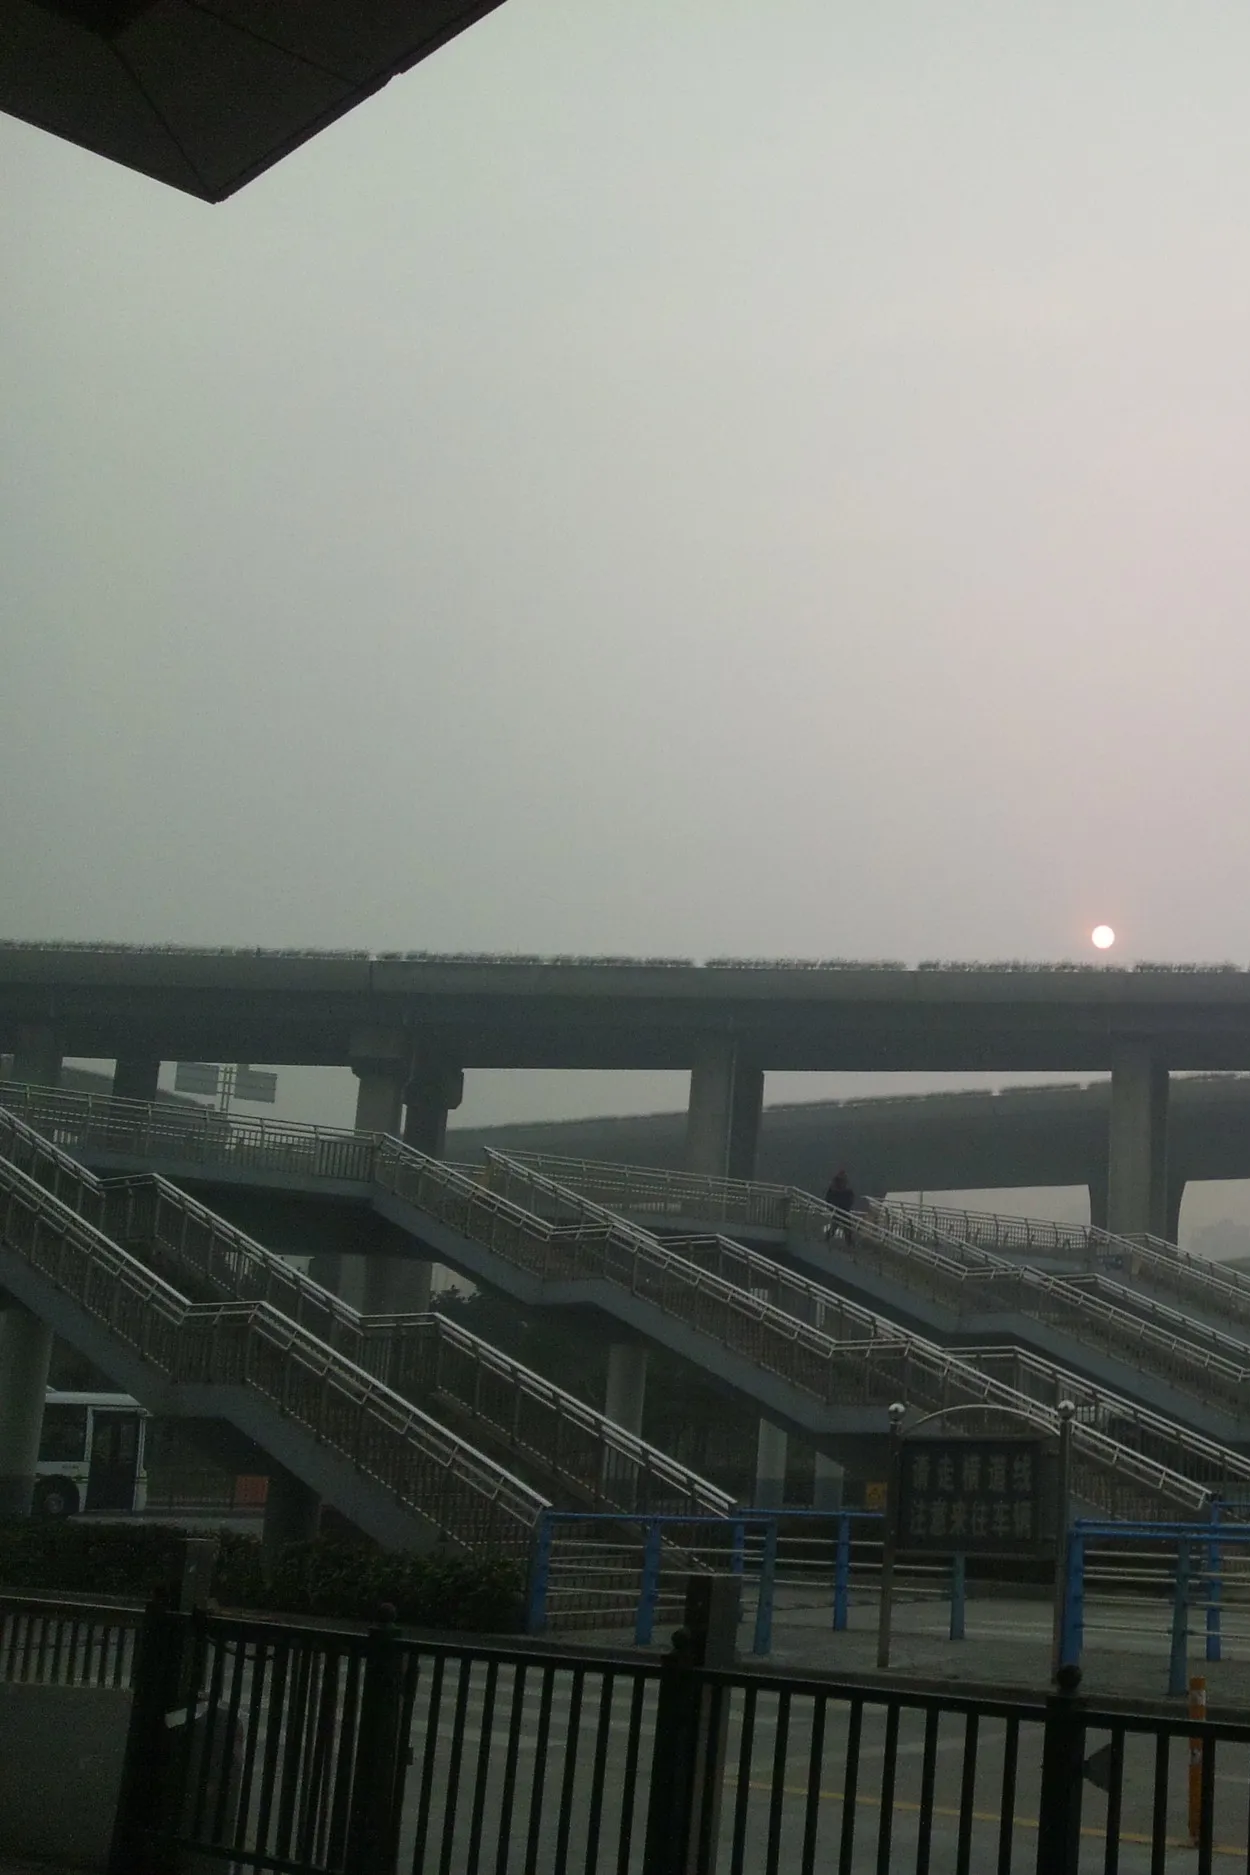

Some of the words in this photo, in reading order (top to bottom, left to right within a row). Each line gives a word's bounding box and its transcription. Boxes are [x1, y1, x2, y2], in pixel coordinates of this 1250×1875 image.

[909, 1497, 1031, 1539] 注意来往车辆
